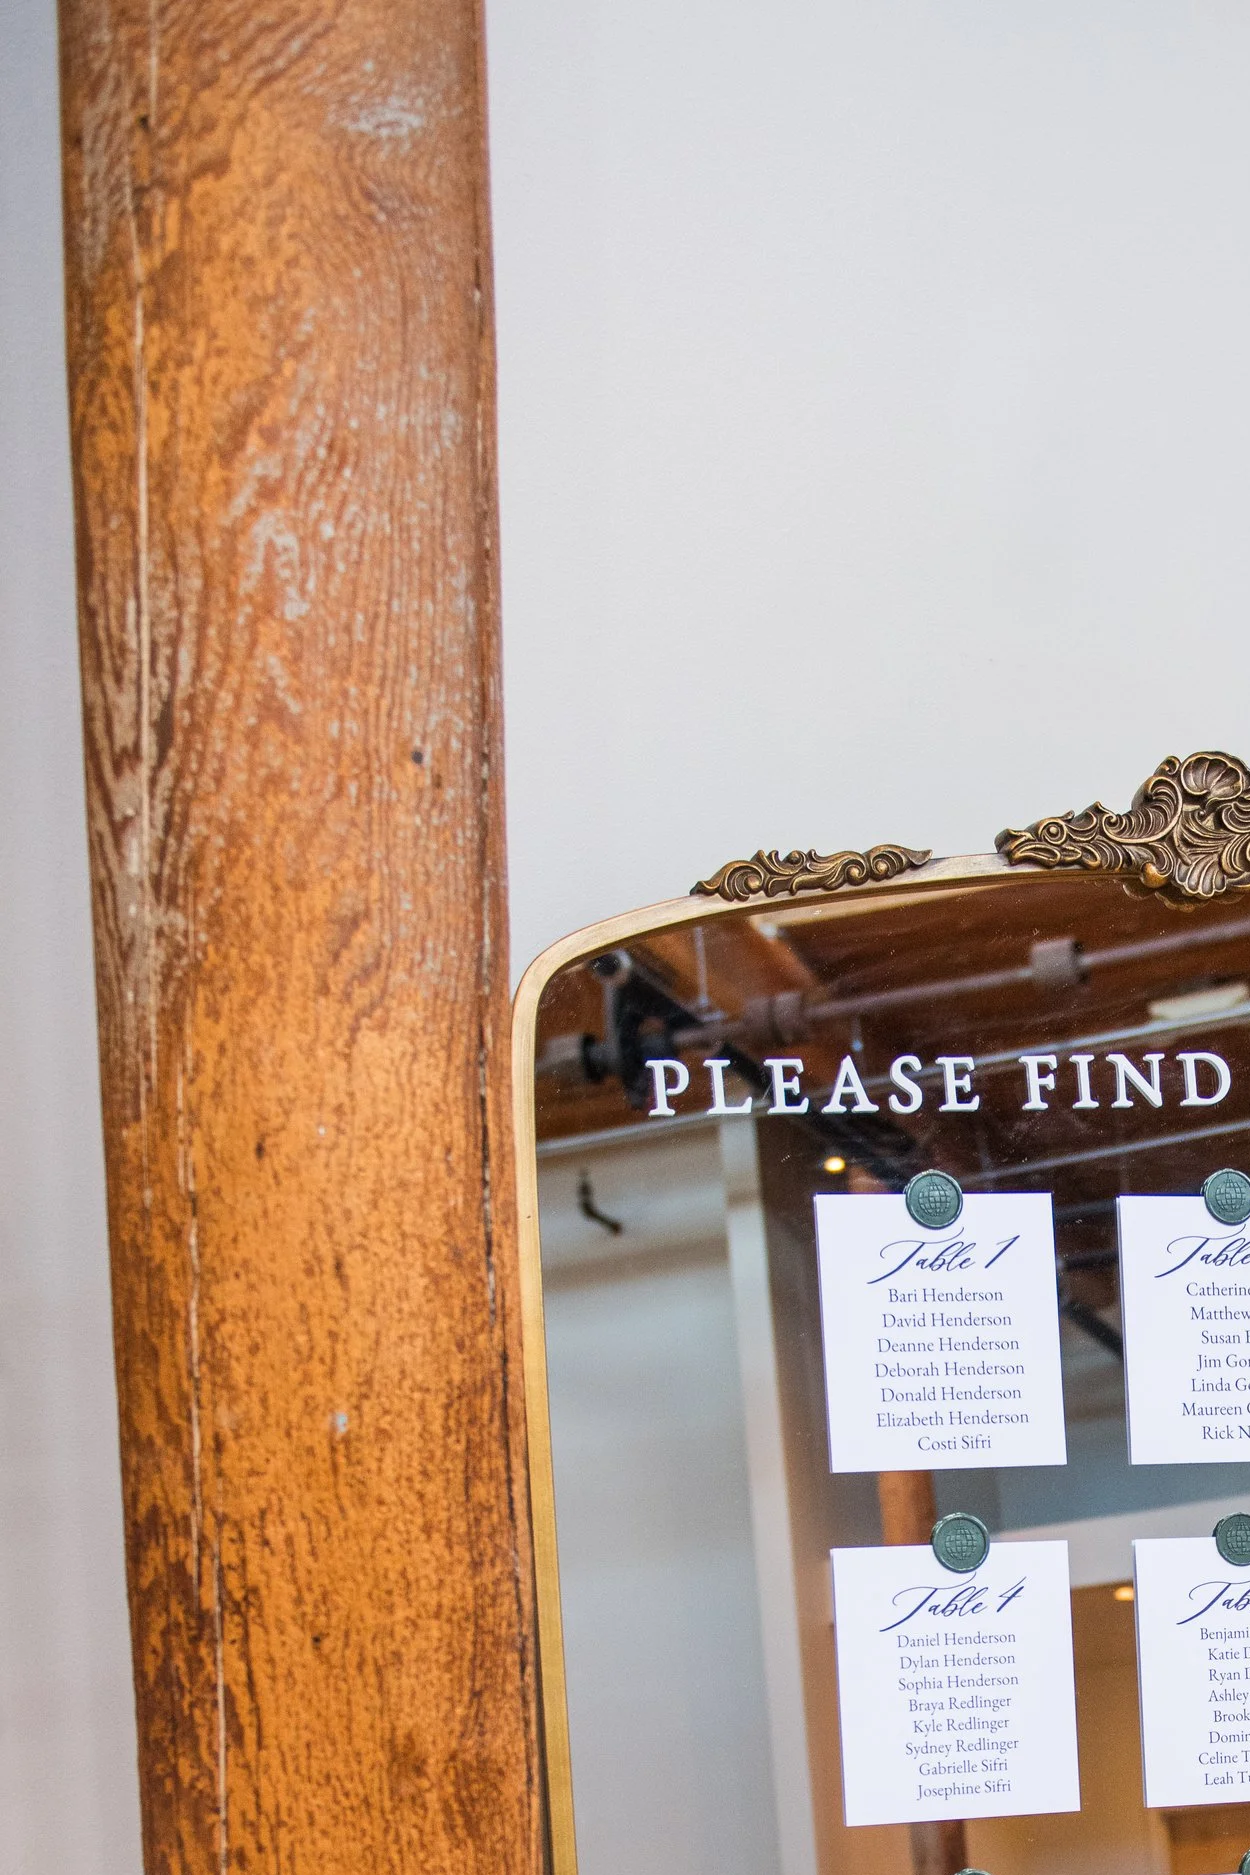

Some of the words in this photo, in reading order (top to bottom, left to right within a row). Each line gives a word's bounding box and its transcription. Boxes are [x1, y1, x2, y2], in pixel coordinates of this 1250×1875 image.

[645, 1054, 980, 1117] PLEASE
[1018, 1051, 1232, 1111] FIND
[866, 1226, 977, 1285] Table
[984, 1234, 1021, 1270] 1
[881, 1312, 927, 1328] David
[931, 1311, 1012, 1327] Henderson
[1196, 1354, 1222, 1372] Jim
[876, 1410, 944, 1428] Elizabeth
[948, 1409, 1029, 1426] Henderson
[1202, 1424, 1235, 1440] Rick
[917, 1436, 957, 1451] Costi
[961, 1433, 992, 1450] Sifri
[878, 1572, 989, 1633] Table
[996, 1575, 1027, 1614] 4
[897, 1632, 940, 1648] Daniel
[944, 1631, 1016, 1646] Henderson
[1207, 1687, 1250, 1706] Ashley
[913, 1718, 943, 1738] Kyle
[946, 1716, 1010, 1734] Redlinger
[916, 1782, 981, 1801] Josephine
[984, 1778, 1011, 1794] Sifri
